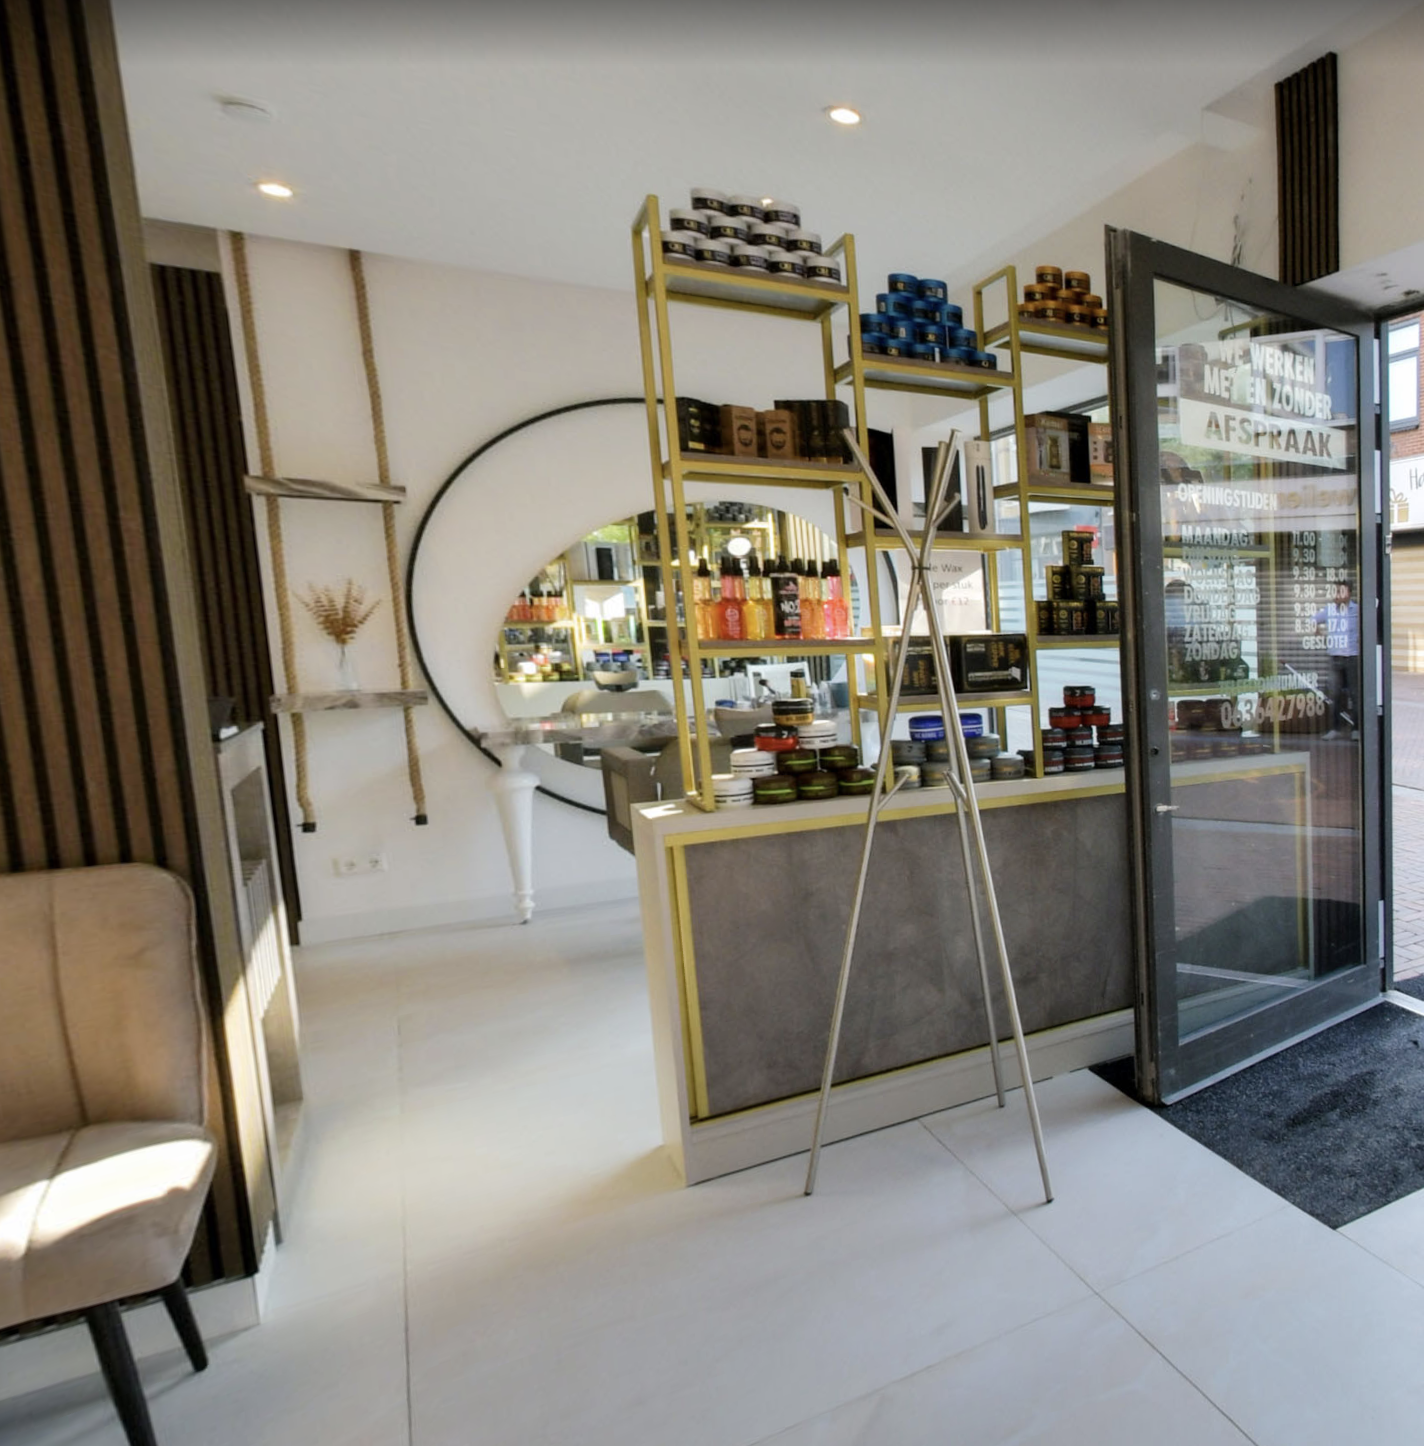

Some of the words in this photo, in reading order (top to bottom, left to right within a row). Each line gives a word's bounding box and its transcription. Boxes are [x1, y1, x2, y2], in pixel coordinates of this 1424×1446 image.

[1219, 339, 1244, 366] WE
[1250, 343, 1315, 385] WERKEN
[1204, 364, 1238, 400] MET
[1249, 378, 1267, 407] EN
[1272, 382, 1332, 420] ZONDER
[1205, 411, 1333, 459] AFSPRAAK
[1177, 483, 1278, 511] OPENINGSTIJDEN
[1182, 525, 1249, 547] MAANDAG
[941, 563, 963, 573] Wax
[1293, 566, 1316, 581] 9.30
[1294, 584, 1316, 599] 9.30
[1294, 602, 1317, 617] 9.30
[1294, 618, 1318, 633] 8.30
[1185, 641, 1239, 662] ZONDAG
